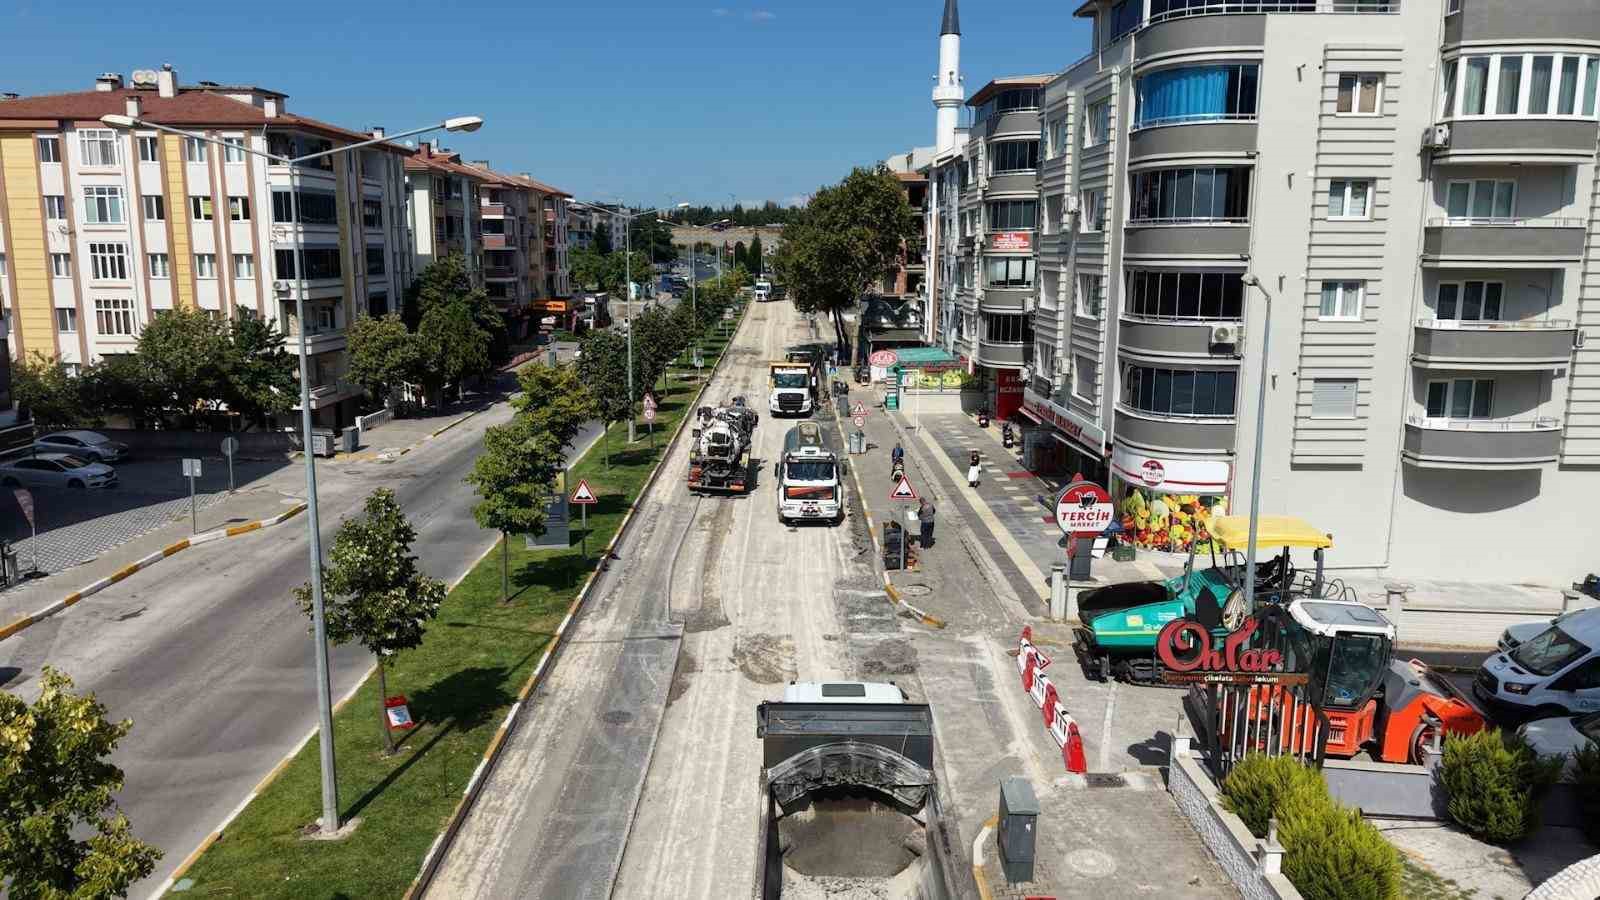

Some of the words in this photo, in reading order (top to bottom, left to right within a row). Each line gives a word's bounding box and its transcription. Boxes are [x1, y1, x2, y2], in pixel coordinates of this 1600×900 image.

[1061, 508, 1110, 521] TERCİH
[1204, 673, 1233, 683] çikolata
[1255, 673, 1279, 682] lokum
